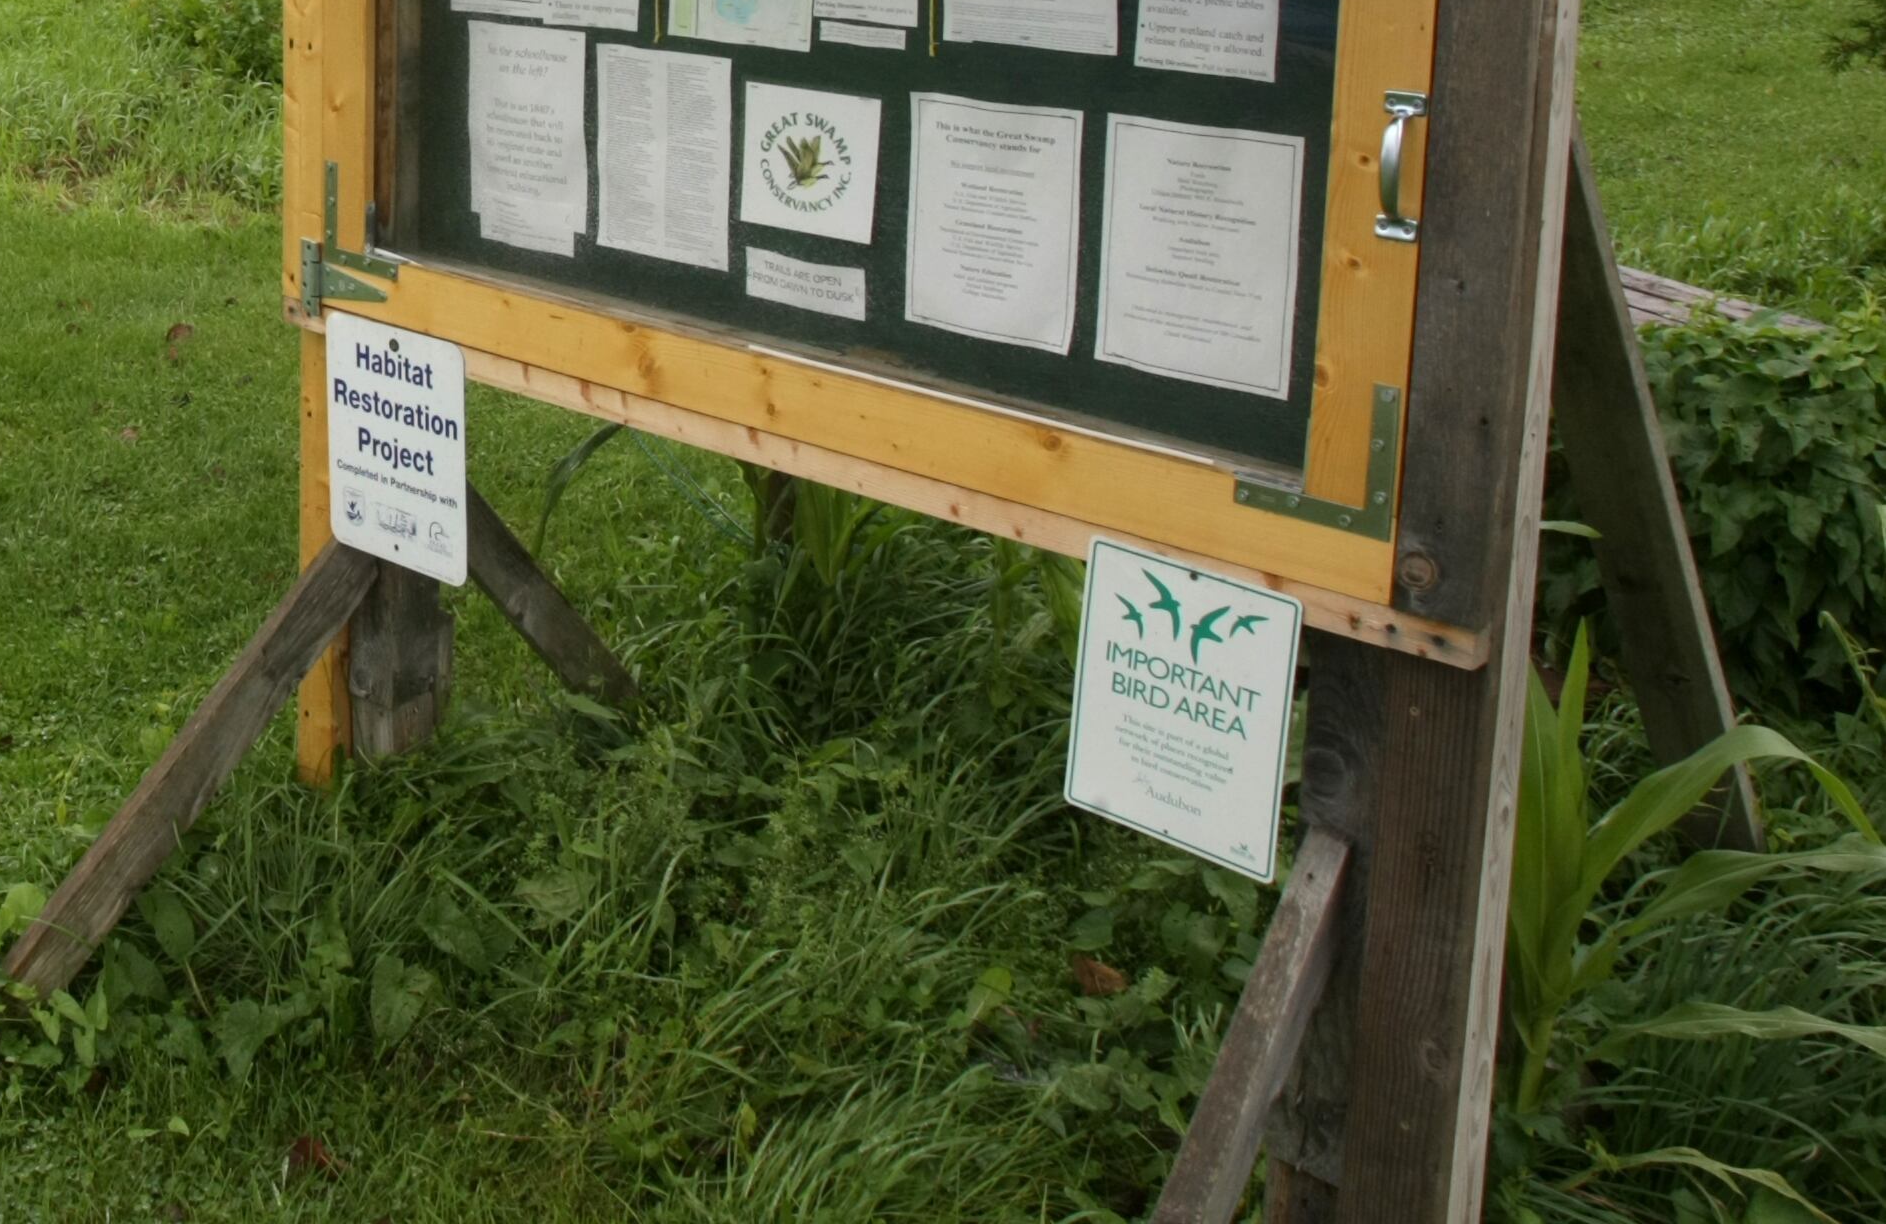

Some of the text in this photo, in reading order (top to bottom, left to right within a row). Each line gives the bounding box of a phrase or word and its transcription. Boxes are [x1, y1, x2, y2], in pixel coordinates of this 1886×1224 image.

[760, 112, 852, 166] GREAT SWAMP
[760, 158, 852, 213] CONSERVANCY INC.
[764, 260, 791, 277] TRAILS
[812, 272, 842, 288] OPEN
[810, 285, 824, 298] TO
[825, 287, 855, 303] DUSK
[356, 342, 433, 390] Habitat
[333, 377, 458, 441] Restoration
[358, 426, 434, 476] Project
[337, 458, 458, 509] Completed in Partnership with
[1106, 639, 1262, 713] IMPORTANT
[1111, 671, 1247, 741] BIRD AREA
[1145, 785, 1203, 817] Audubon
